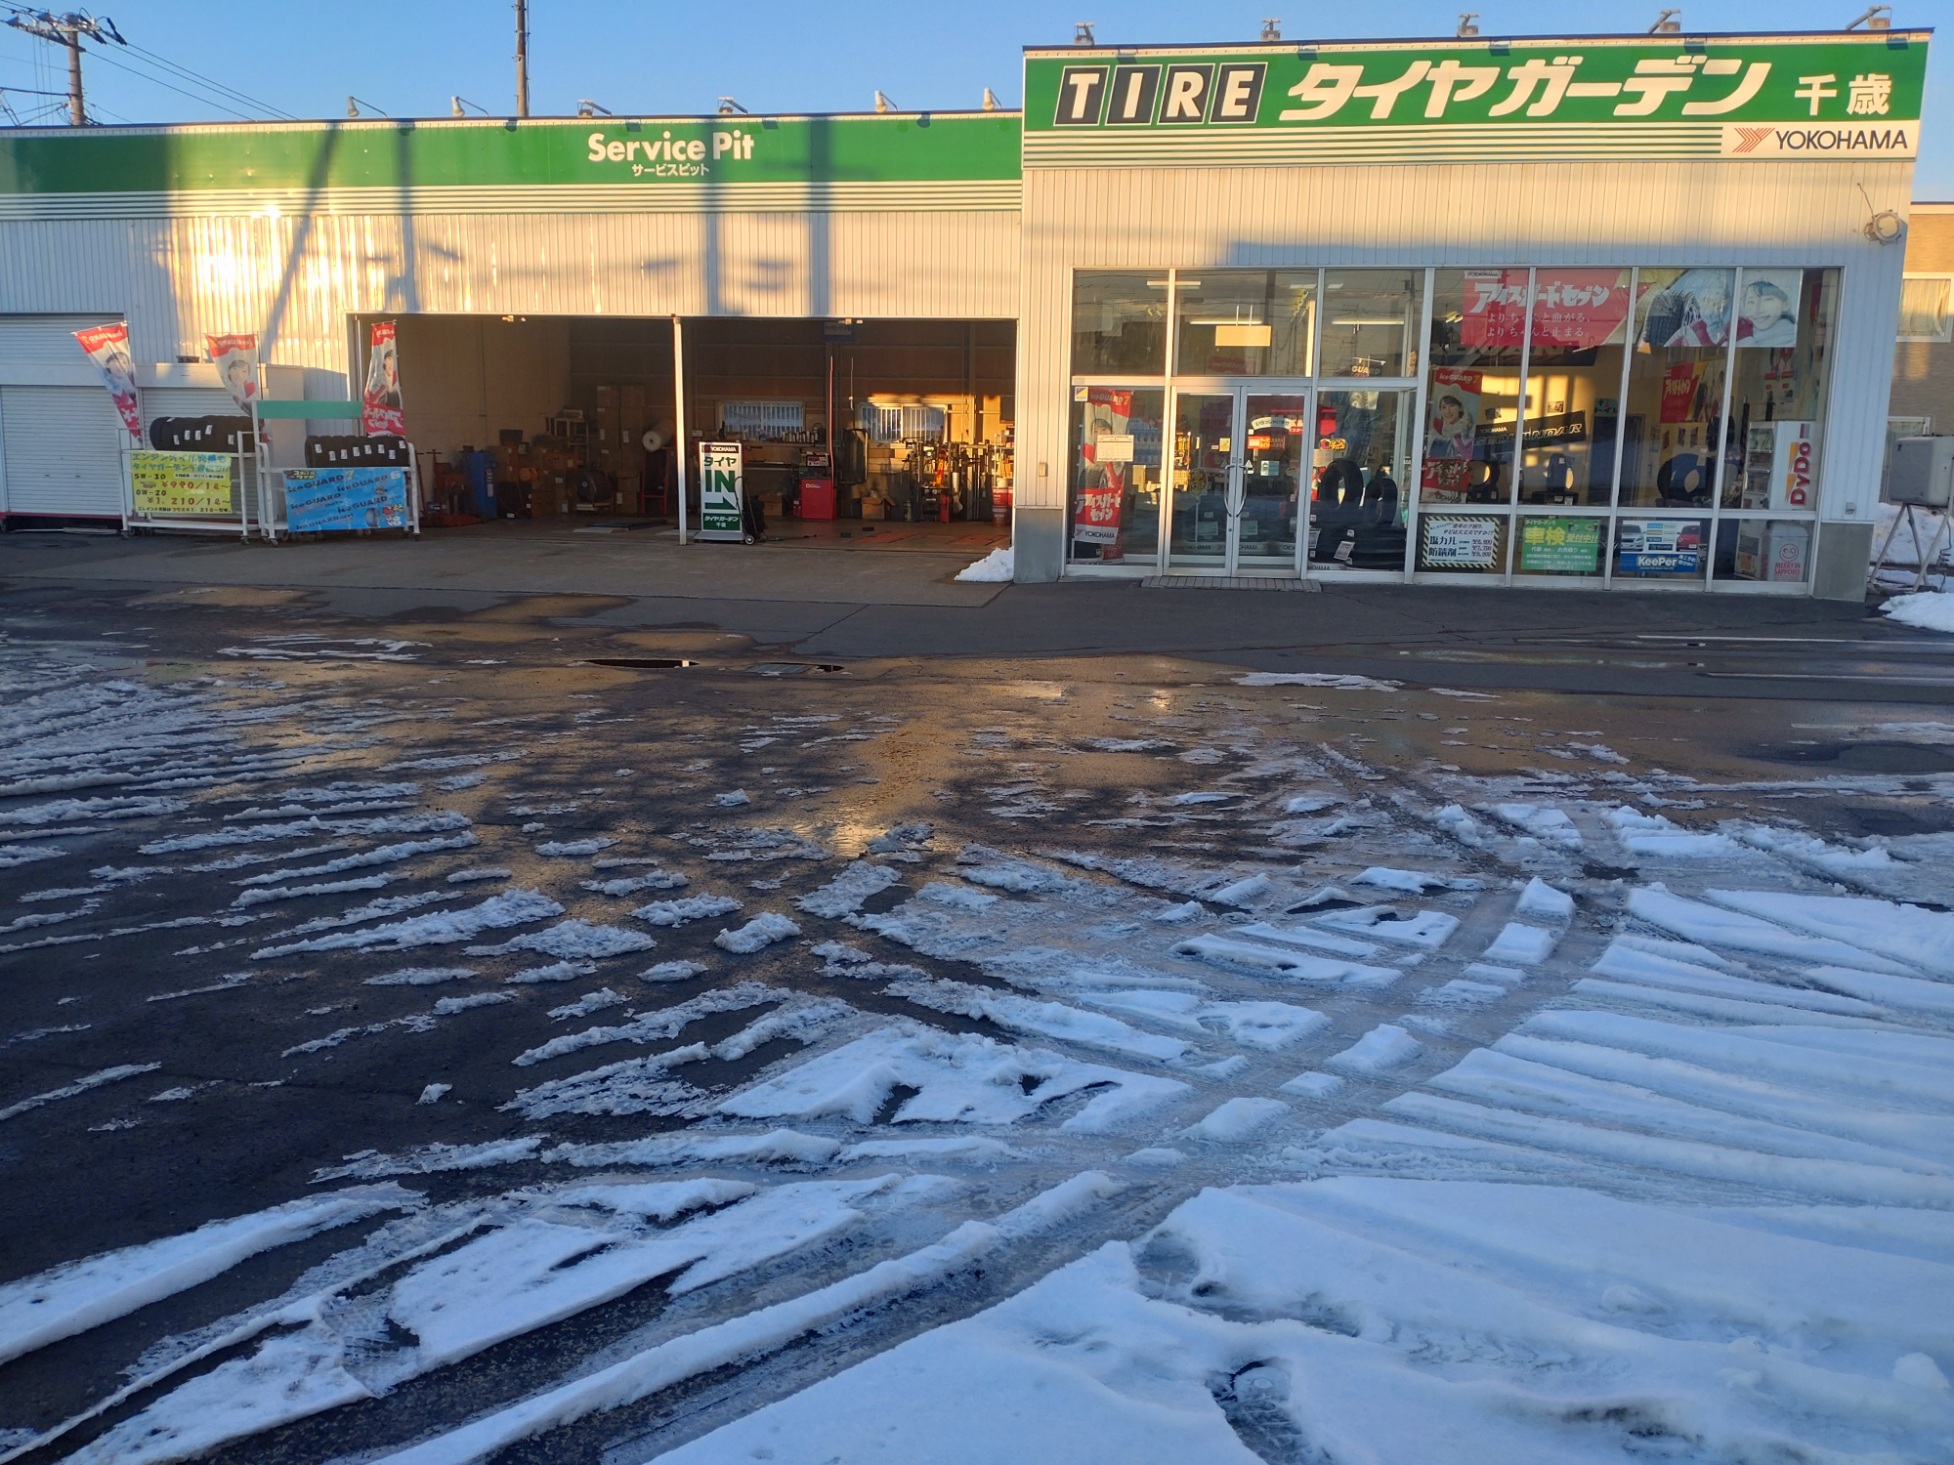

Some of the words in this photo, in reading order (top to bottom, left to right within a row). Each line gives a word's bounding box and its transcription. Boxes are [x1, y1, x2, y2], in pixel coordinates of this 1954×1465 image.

[1068, 69, 1256, 119] TIRE
[1279, 55, 1772, 121] タイヤガーデン
[1793, 73, 1893, 117] 千歳
[588, 130, 706, 162] Service
[711, 129, 755, 160] Pit
[1774, 129, 1909, 150] YOKOHAMA
[632, 163, 710, 177] サービスピット
[1123, 395, 1131, 406] 7
[703, 456, 737, 468] タイヤ
[704, 469, 736, 493] IN
[1084, 530, 1116, 539] YOKOHAMA
[1429, 535, 1458, 546] 塩カル
[1524, 525, 1566, 546] 車検
[1638, 555, 1678, 567] KeePer
